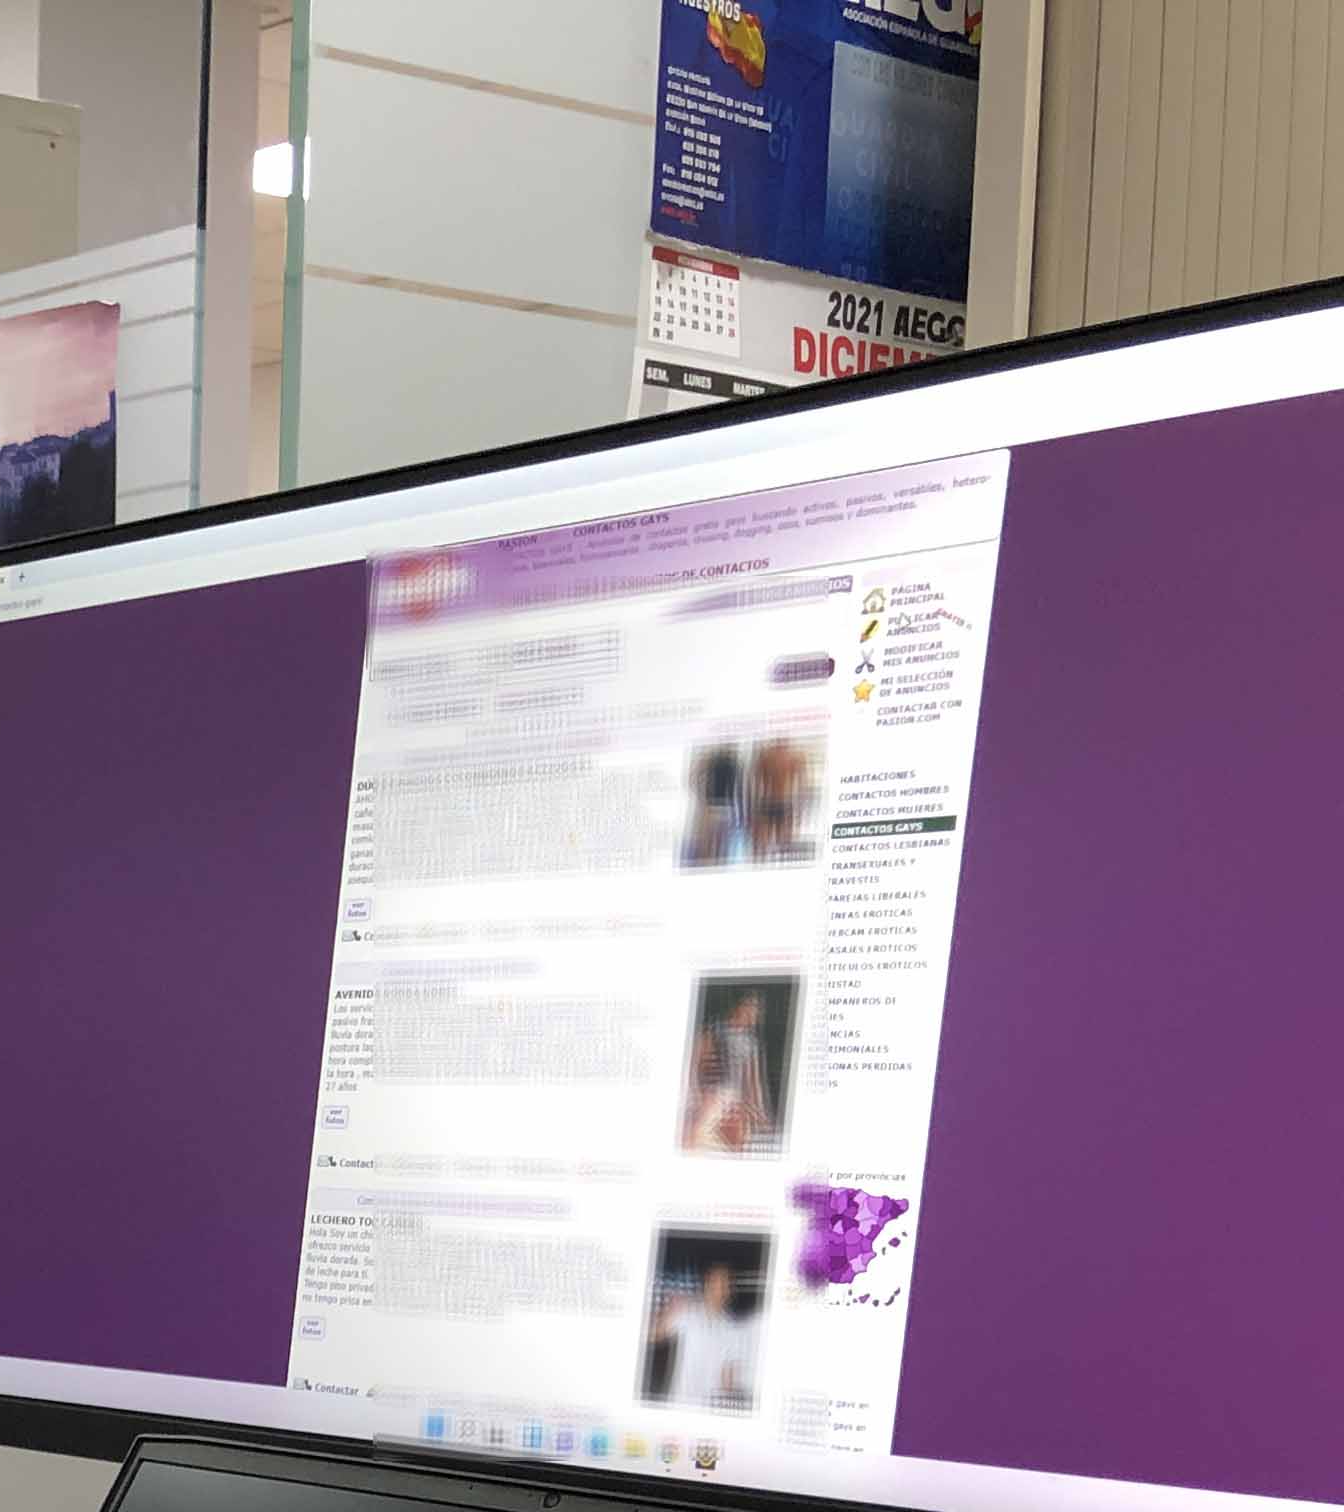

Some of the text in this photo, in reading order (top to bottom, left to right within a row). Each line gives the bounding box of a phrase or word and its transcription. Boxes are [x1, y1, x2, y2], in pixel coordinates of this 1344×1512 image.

[826, 290, 883, 337] 2021
[683, 372, 712, 390] LUNES
[573, 518, 637, 537] CONTACTOS
[640, 512, 671, 527] GAYS
[699, 558, 770, 578] CONTACTOS
[890, 593, 945, 607] PRINCIPAL
[883, 641, 943, 656] MODIFICAR
[883, 650, 960, 667] MIS ANUNCIOS
[881, 670, 953, 685] MI SELECCIÓN
[879, 682, 950, 697] DE ANUNCIOS
[876, 699, 963, 716] CONTACTAR CON
[840, 769, 917, 785] HABITACIONES
[838, 785, 950, 802] CONTACTOS HOMBRES
[836, 803, 944, 819] CONTACTOS MUJERES
[833, 822, 924, 837] CONTACTOS GAYS
[832, 838, 951, 854] CONTACTOS LESBIANAS
[831, 858, 906, 871] TRANSEXUALES
[872, 890, 926, 901] LIBERALES
[334, 989, 374, 1000] AVENID
[339, 1158, 374, 1169] Contact
[311, 1215, 356, 1225] LECHERO
[315, 1383, 359, 1396] Contactar
